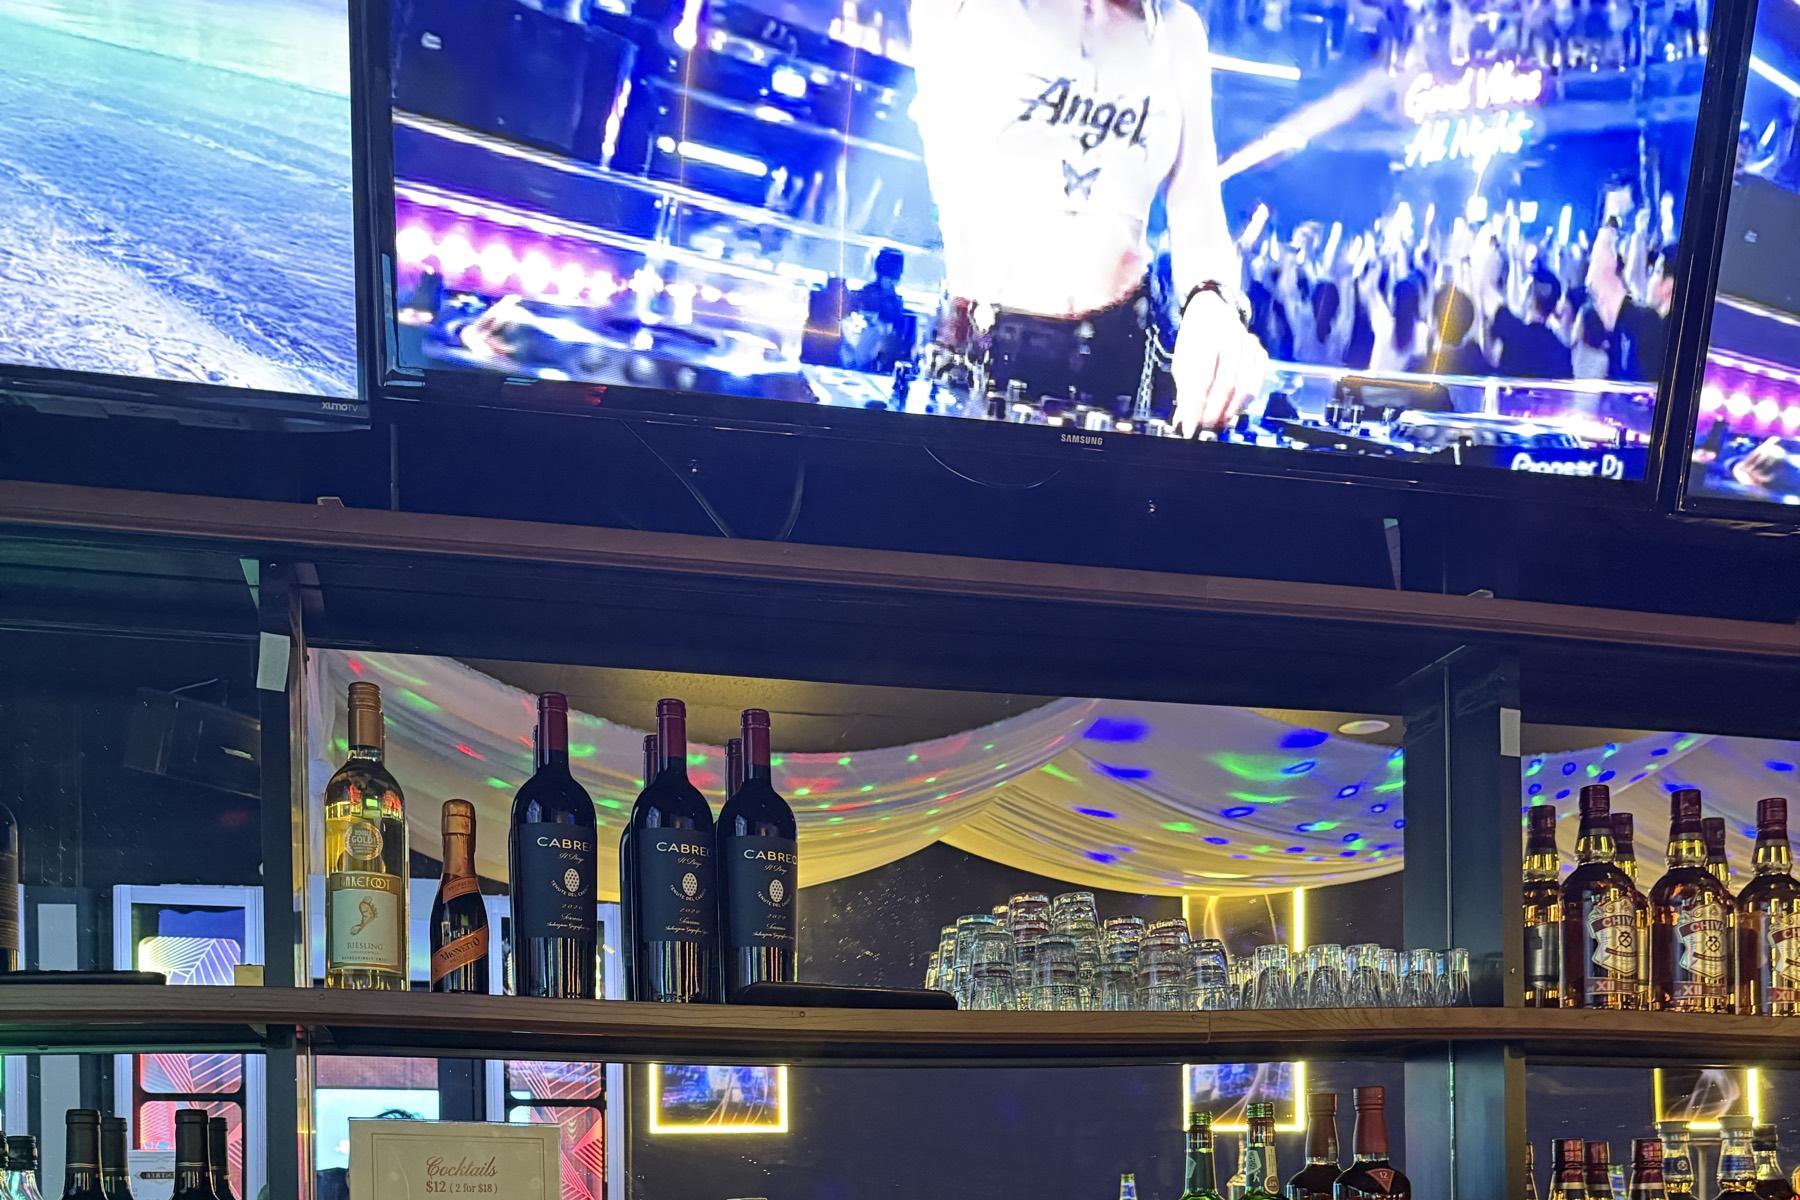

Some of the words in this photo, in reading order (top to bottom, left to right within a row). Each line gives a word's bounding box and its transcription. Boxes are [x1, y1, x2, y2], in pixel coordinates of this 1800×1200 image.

[1017, 77, 1151, 155] Angel
[1060, 433, 1103, 446] SAMSUNG
[536, 836, 592, 852] CABRE
[426, 1156, 498, 1179] Cocktails
[426, 1181, 446, 1194] $12
[462, 1184, 476, 1193] for
